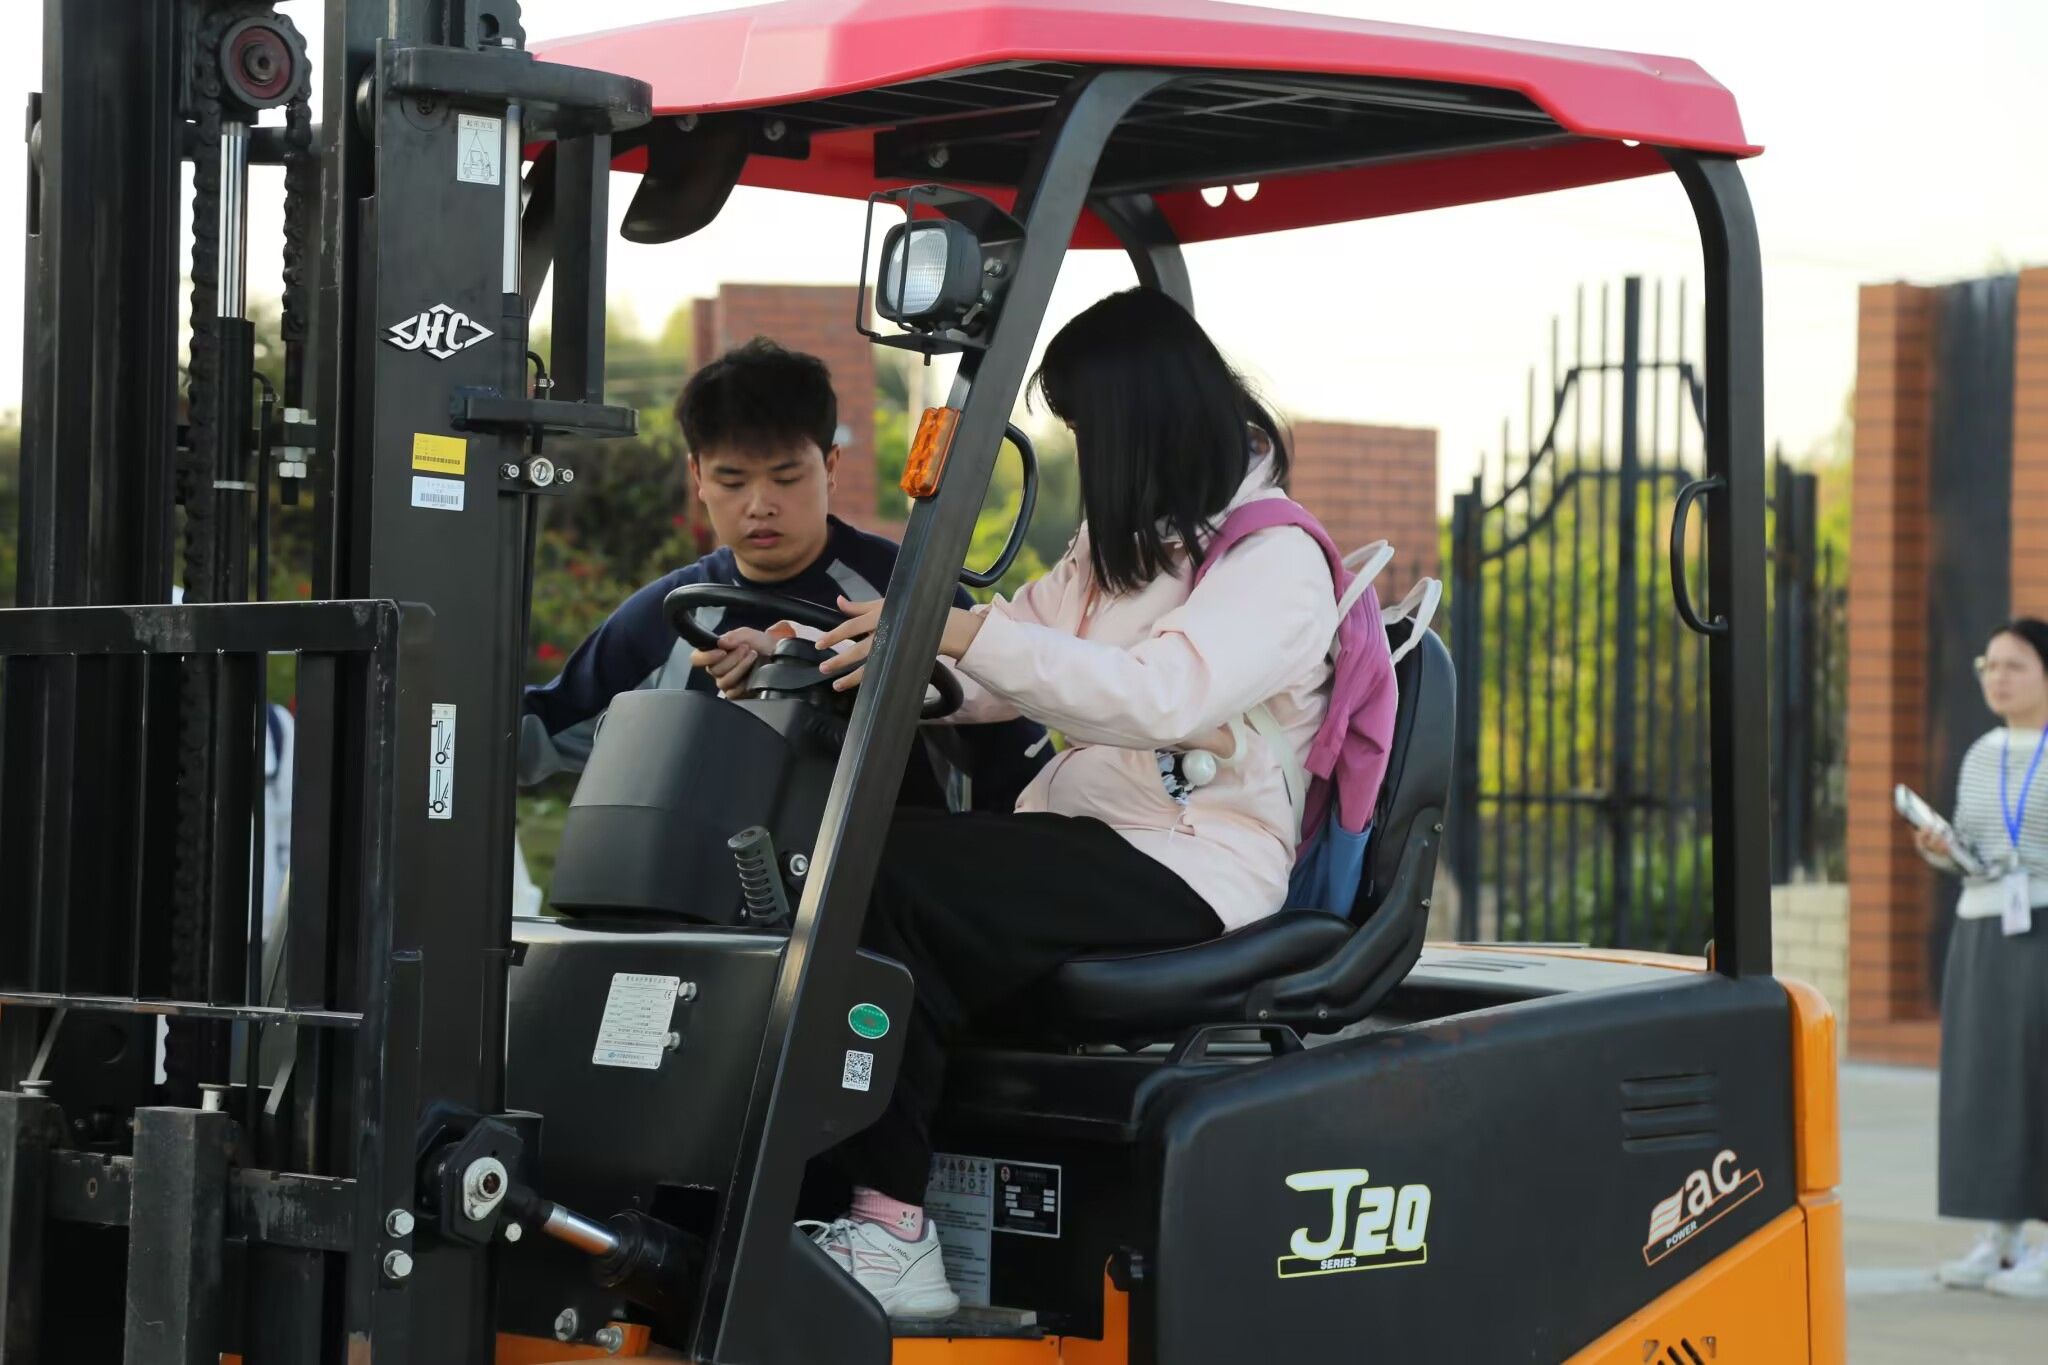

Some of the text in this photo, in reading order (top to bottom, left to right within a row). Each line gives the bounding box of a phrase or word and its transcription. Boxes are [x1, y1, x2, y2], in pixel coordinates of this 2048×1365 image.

[1285, 1168, 1432, 1261] J20
[1665, 1221, 1697, 1248] POWER
[1320, 1256, 1357, 1270] SERIES
